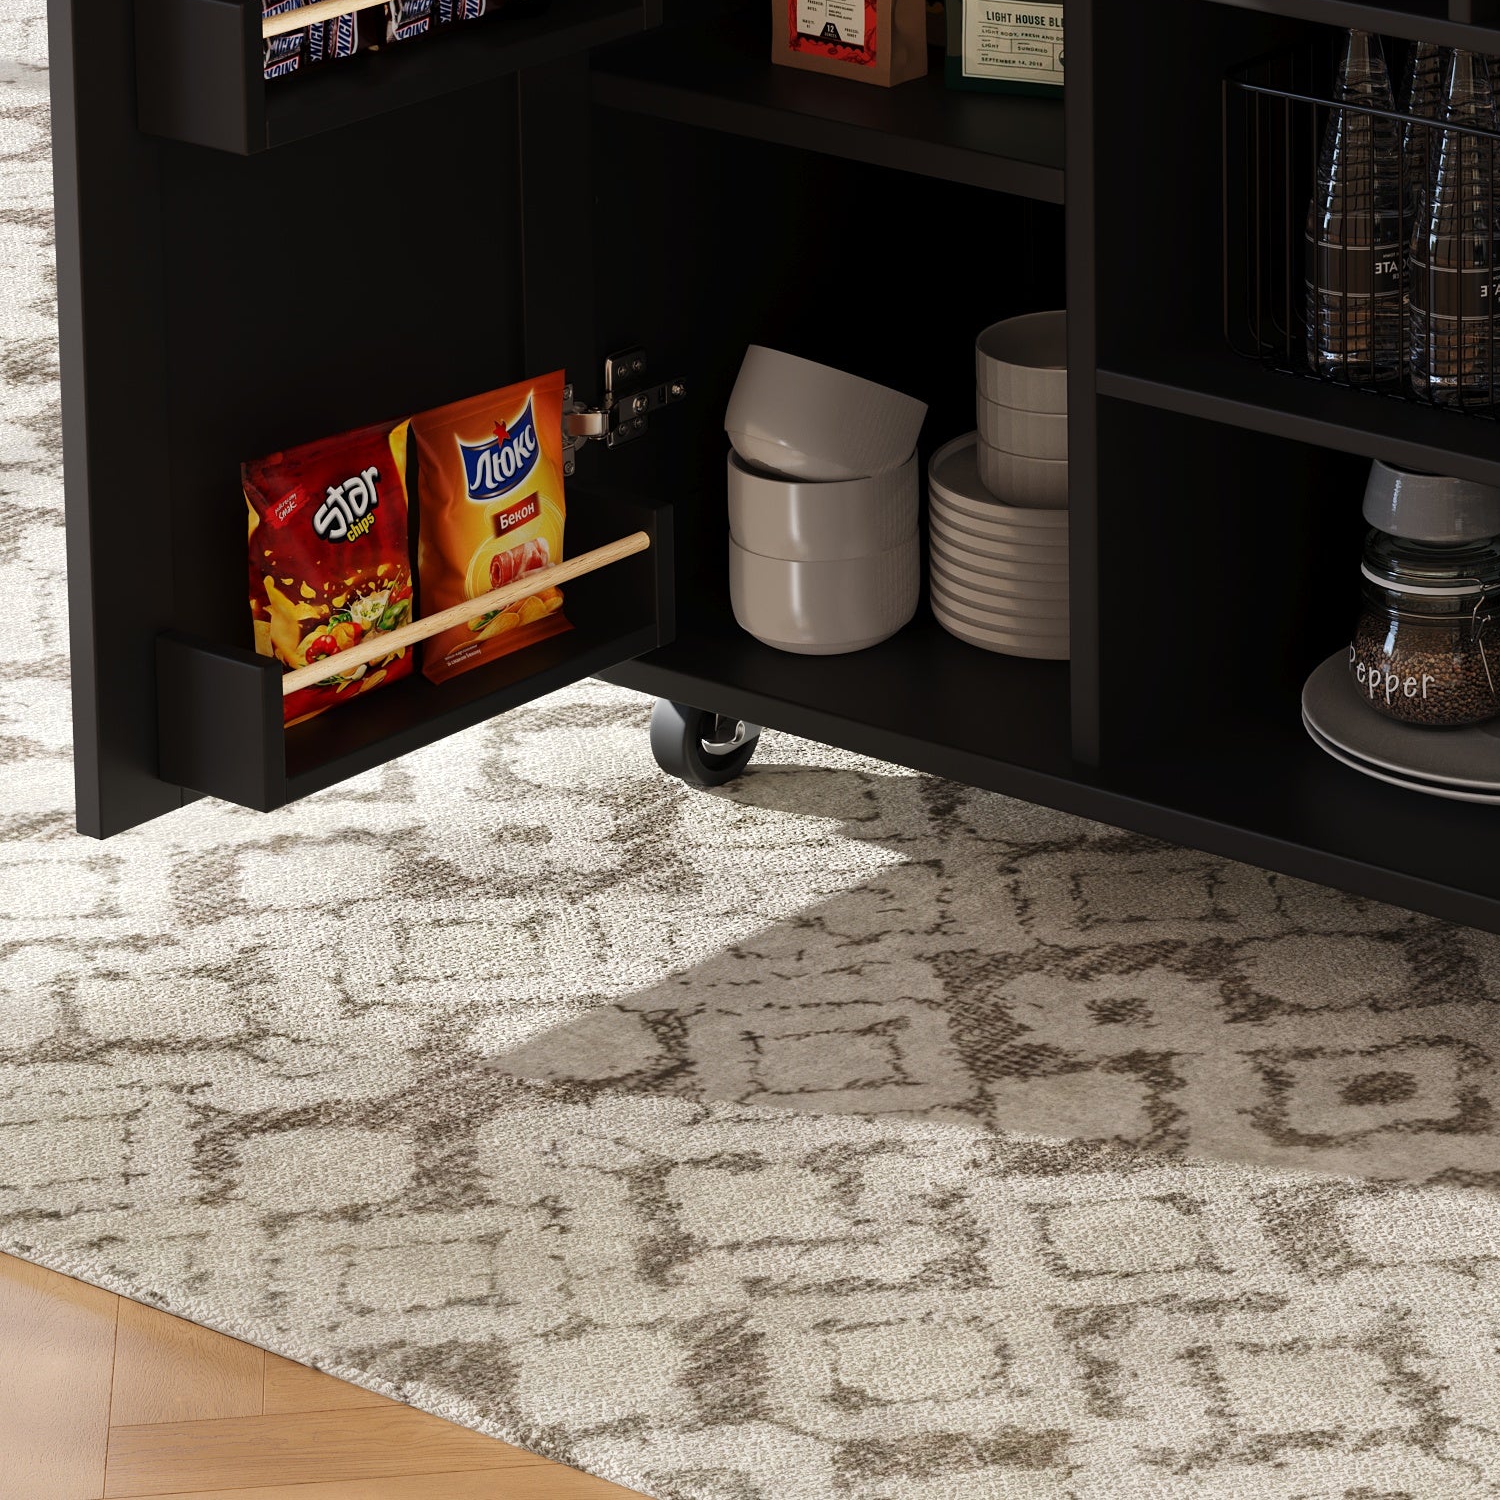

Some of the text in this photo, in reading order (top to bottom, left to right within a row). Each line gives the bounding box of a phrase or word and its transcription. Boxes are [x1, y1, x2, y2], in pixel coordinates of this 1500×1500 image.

[826, 24, 835, 33] 12
[986, 11, 1012, 23] LIGHT
[1015, 14, 1046, 26] HOUSE
[470, 424, 536, 491] Люкс
[313, 466, 379, 539] Star
[500, 502, 536, 530] Бекон
[347, 512, 376, 542] chips
